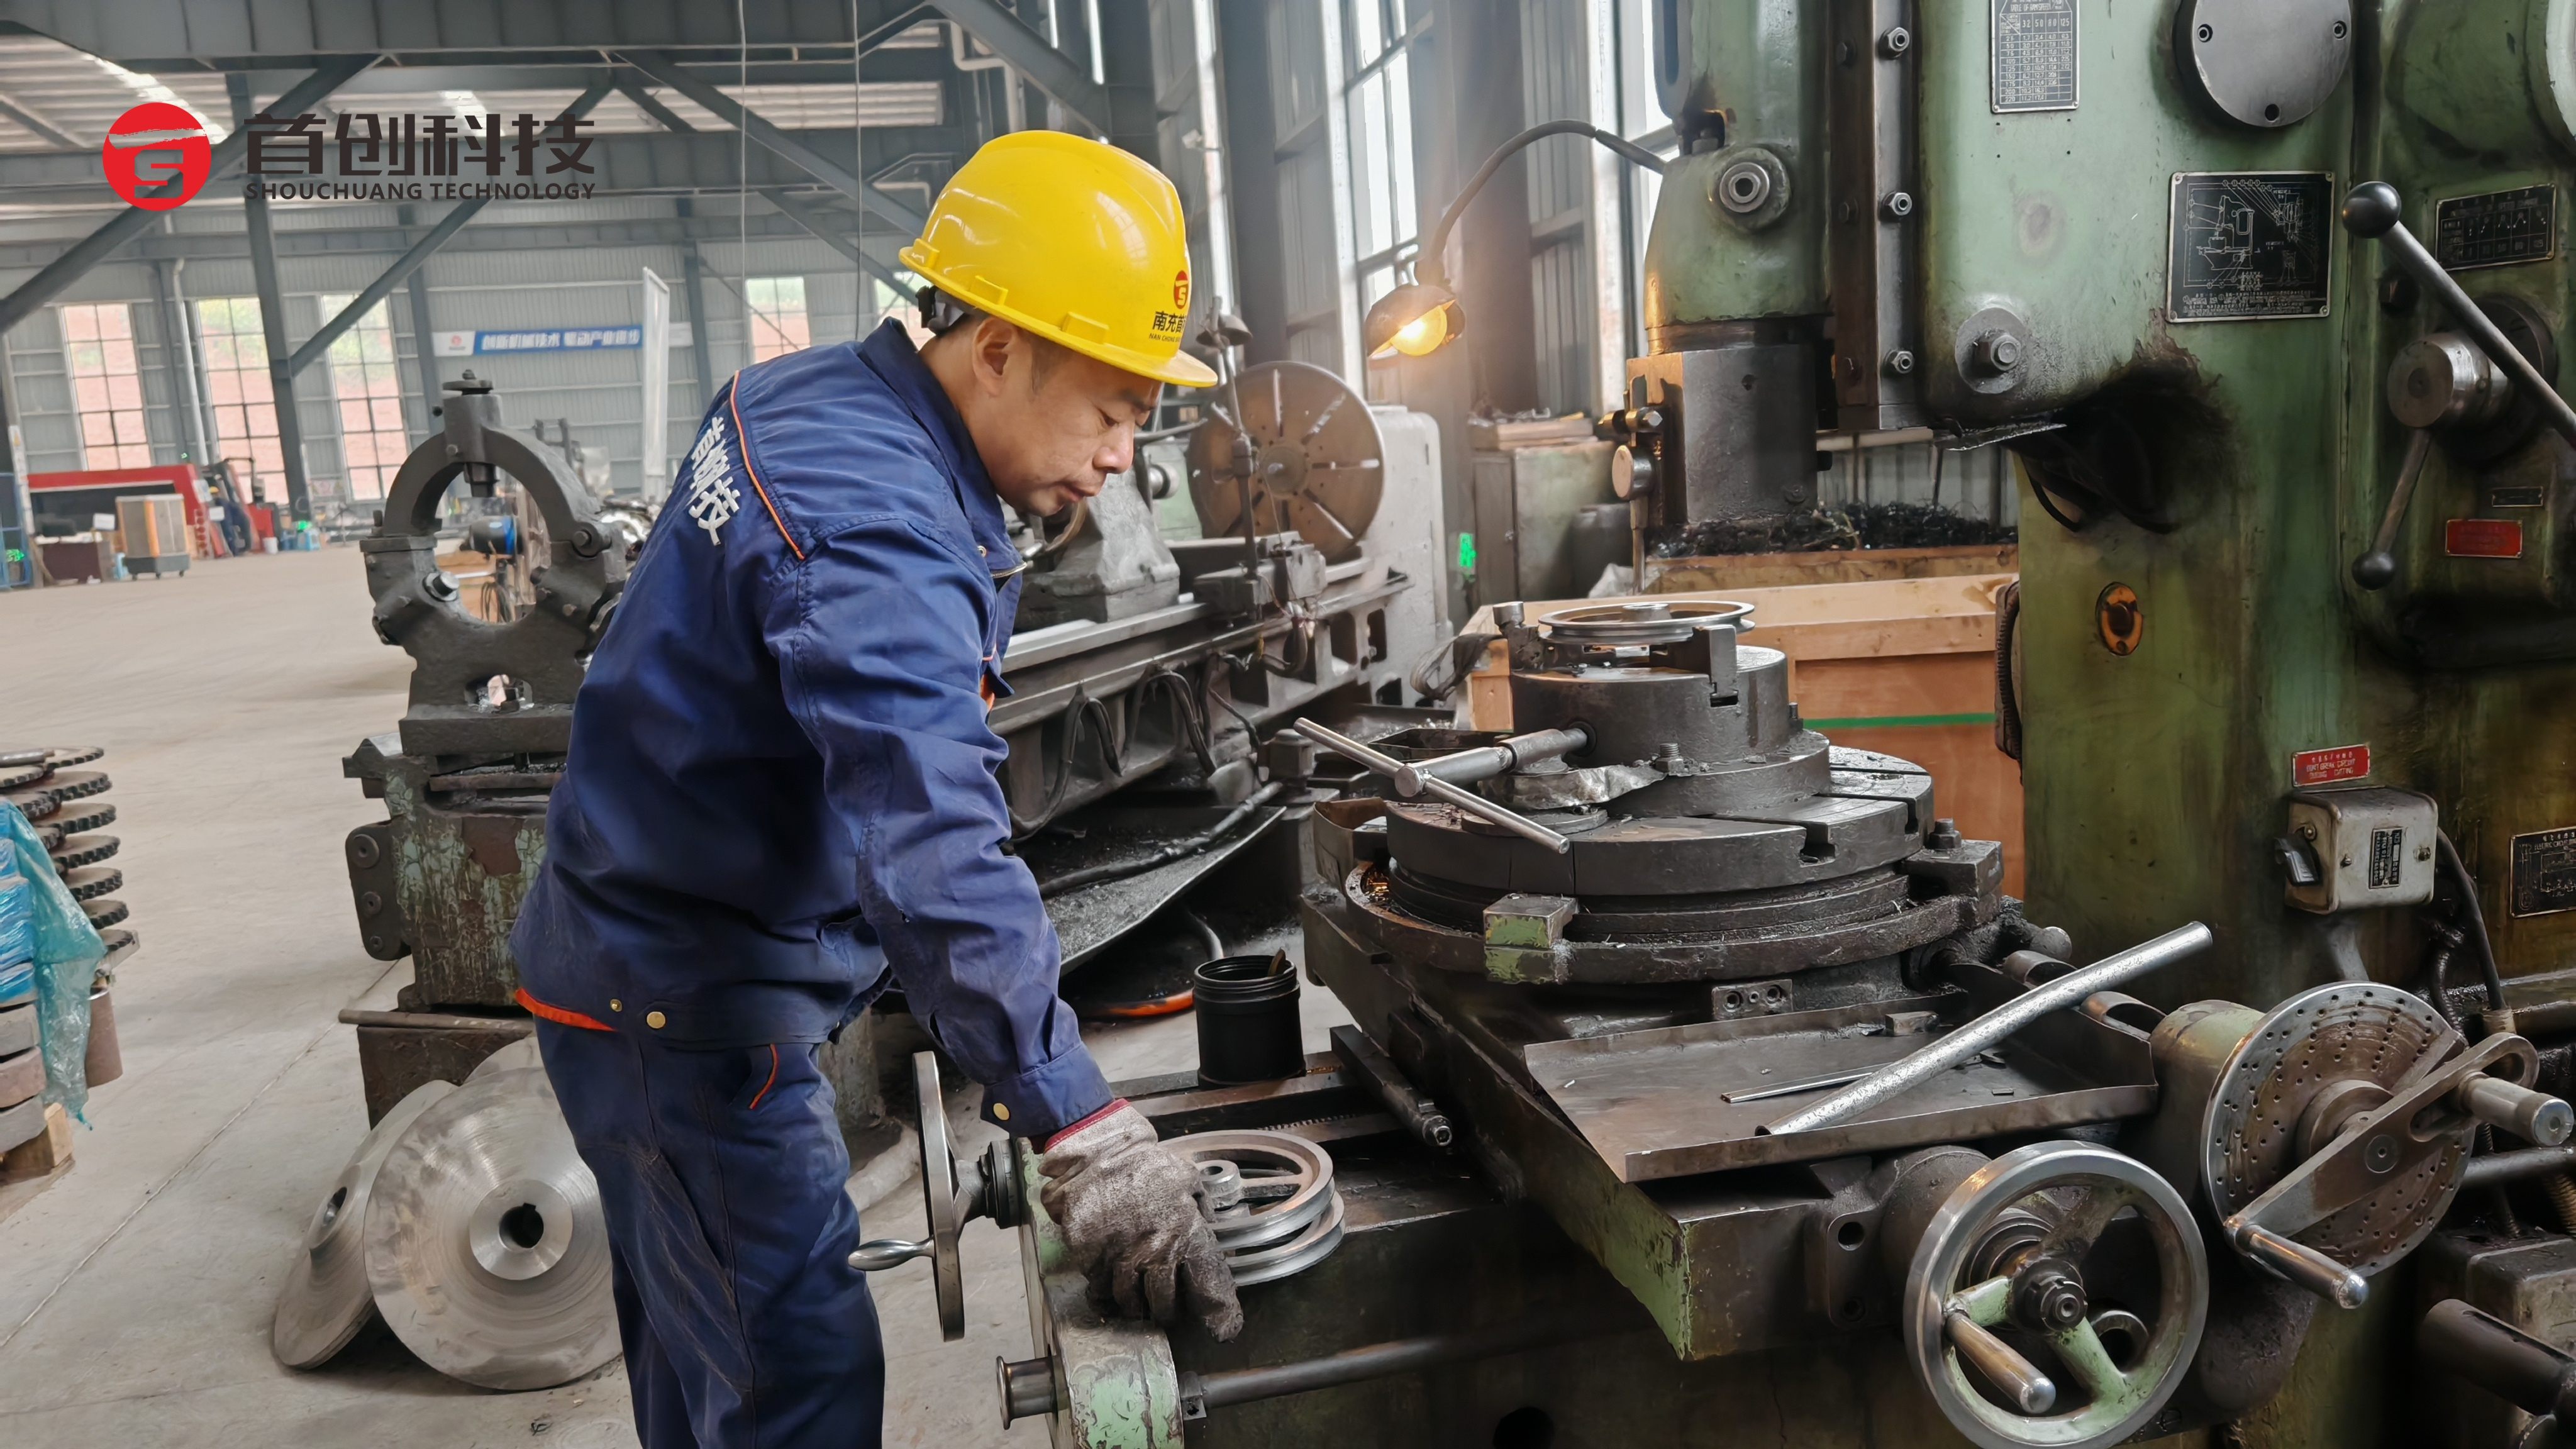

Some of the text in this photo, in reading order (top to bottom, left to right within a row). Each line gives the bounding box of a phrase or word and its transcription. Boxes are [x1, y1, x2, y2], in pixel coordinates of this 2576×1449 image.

[2035, 19, 2043, 27] 50
[1152, 311, 1186, 333] 南充首
